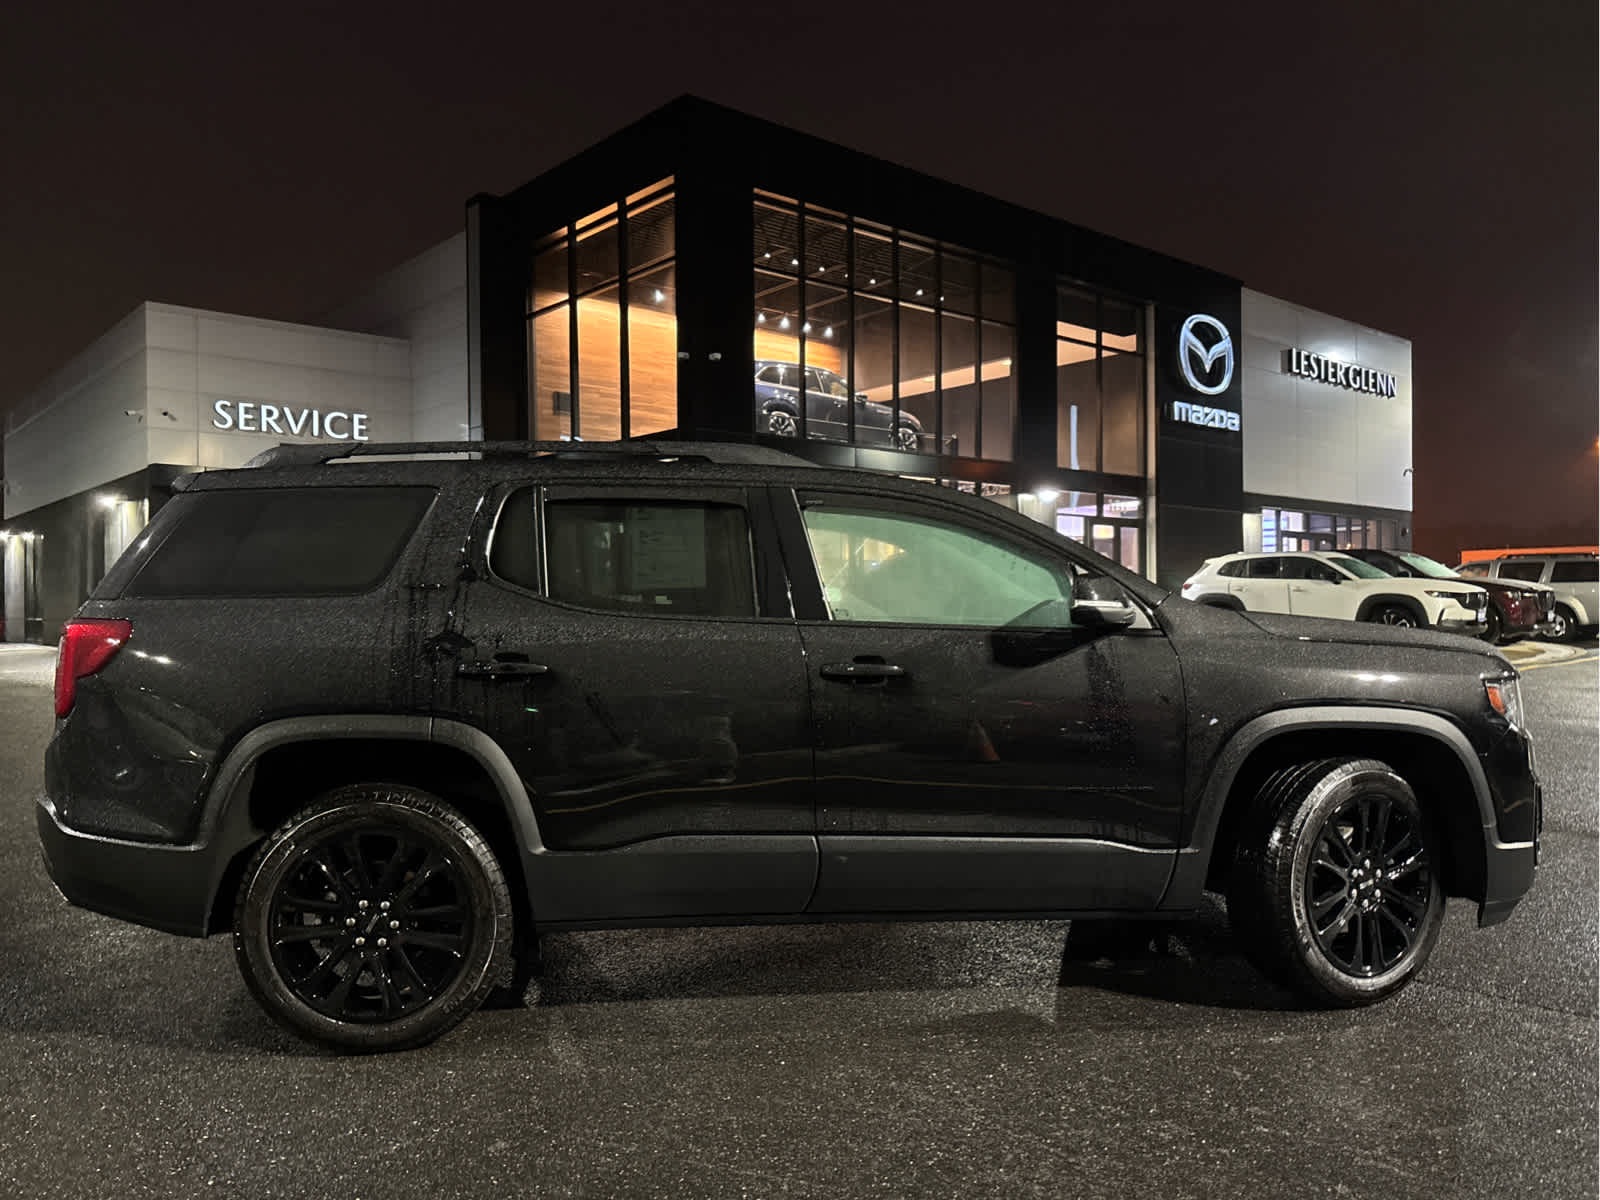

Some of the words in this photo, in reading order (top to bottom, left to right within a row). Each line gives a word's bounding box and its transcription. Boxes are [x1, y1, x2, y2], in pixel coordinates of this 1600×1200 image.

[1291, 348, 1347, 386] LESTER
[1348, 364, 1398, 397] GLENN
[212, 400, 369, 441] SERVICE
